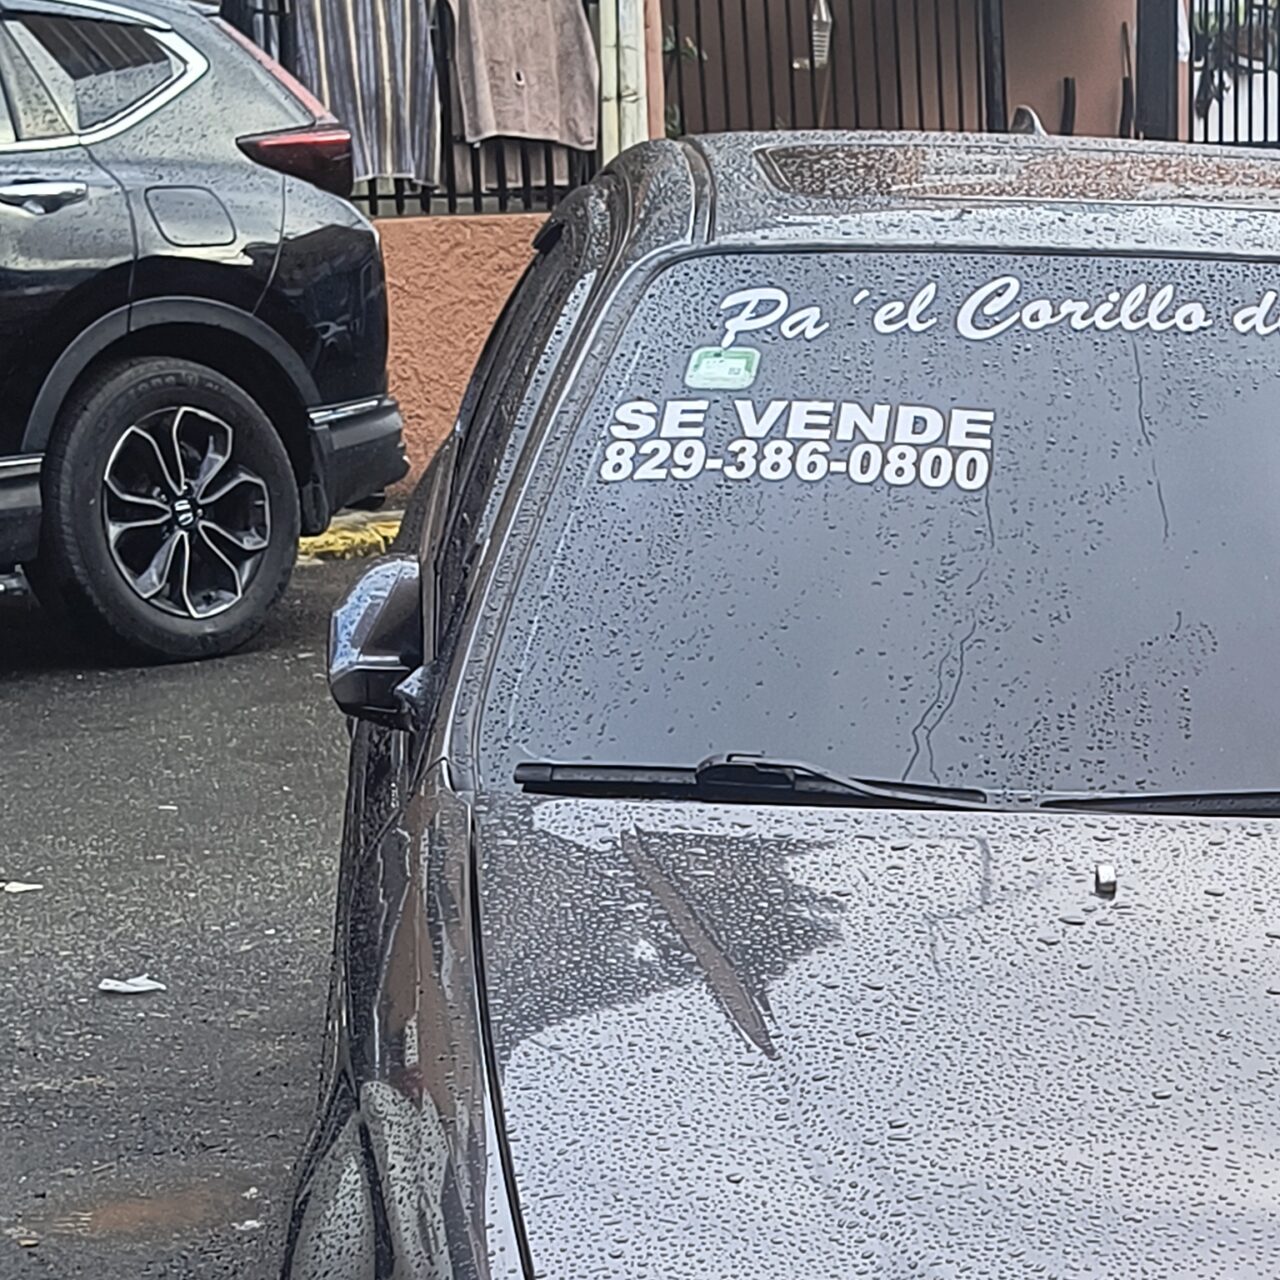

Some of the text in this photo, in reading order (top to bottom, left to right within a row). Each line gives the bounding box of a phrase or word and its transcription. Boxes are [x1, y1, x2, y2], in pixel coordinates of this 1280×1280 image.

[720, 287, 829, 349] Pa
[956, 276, 1213, 340] Corillo
[609, 398, 995, 449] SE VENDE
[599, 438, 990, 491] 829-386-0800
